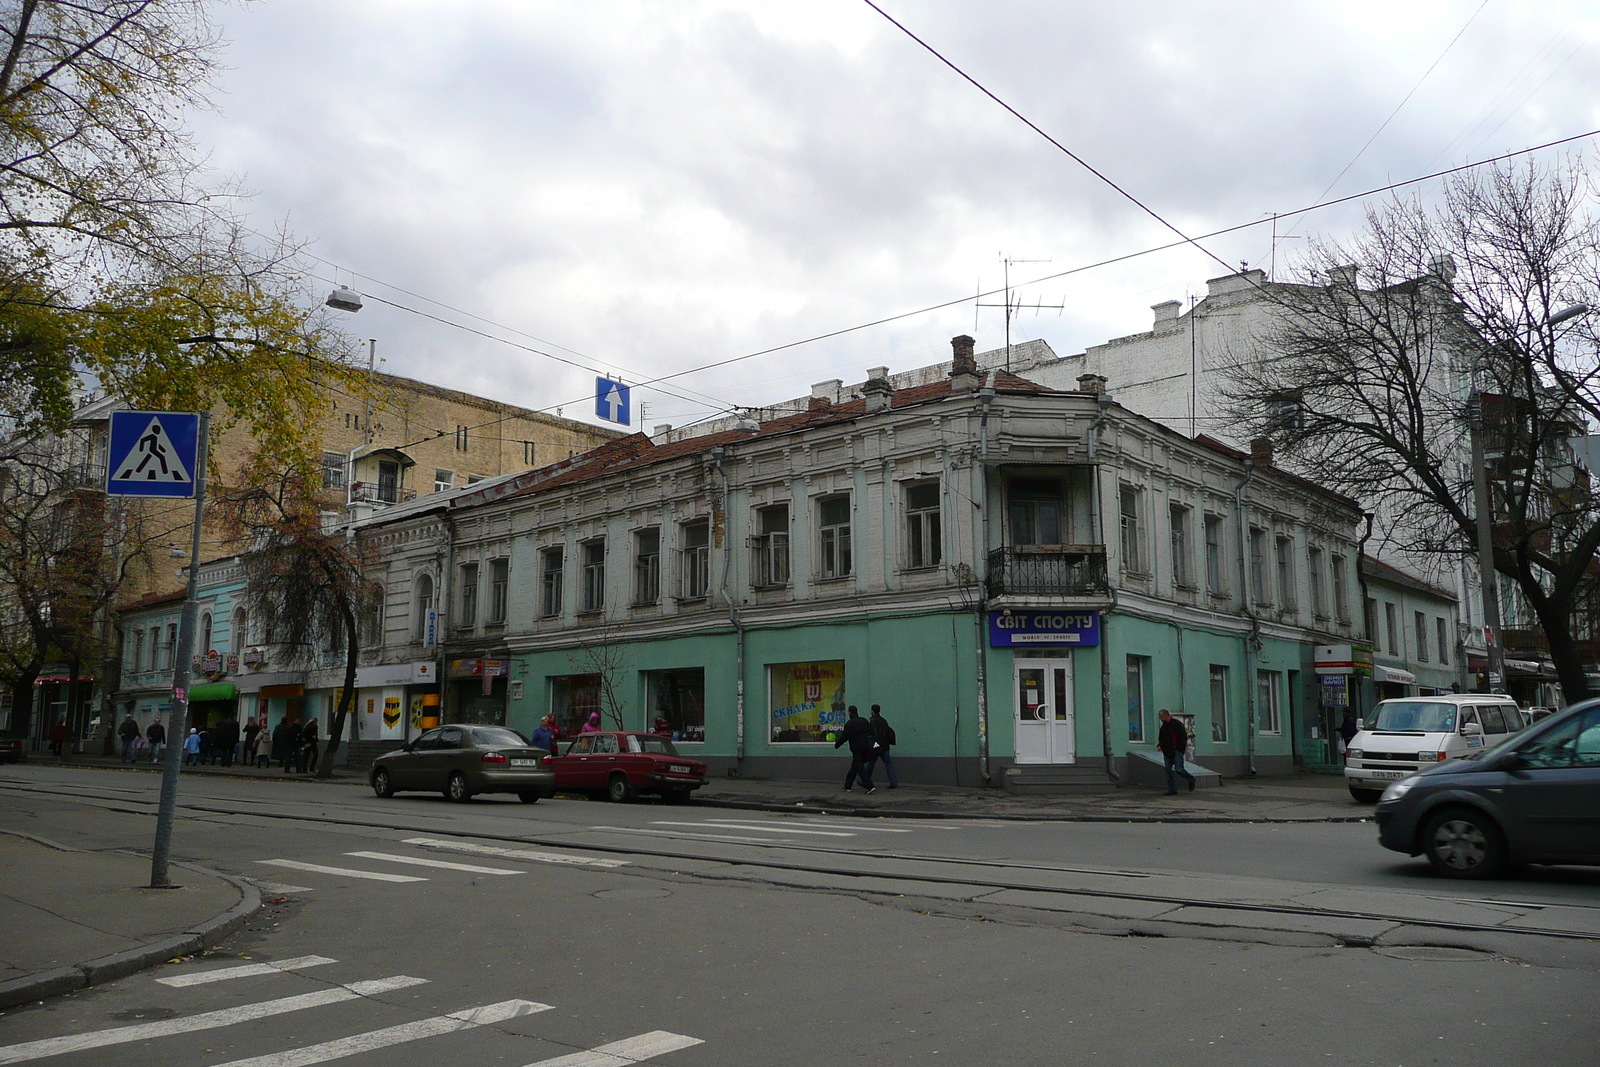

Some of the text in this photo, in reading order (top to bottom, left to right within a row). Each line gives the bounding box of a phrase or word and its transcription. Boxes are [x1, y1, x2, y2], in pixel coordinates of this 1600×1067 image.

[996, 615, 1093, 629] СВІТ СПОРТУ
[818, 711, 845, 723] 50%
